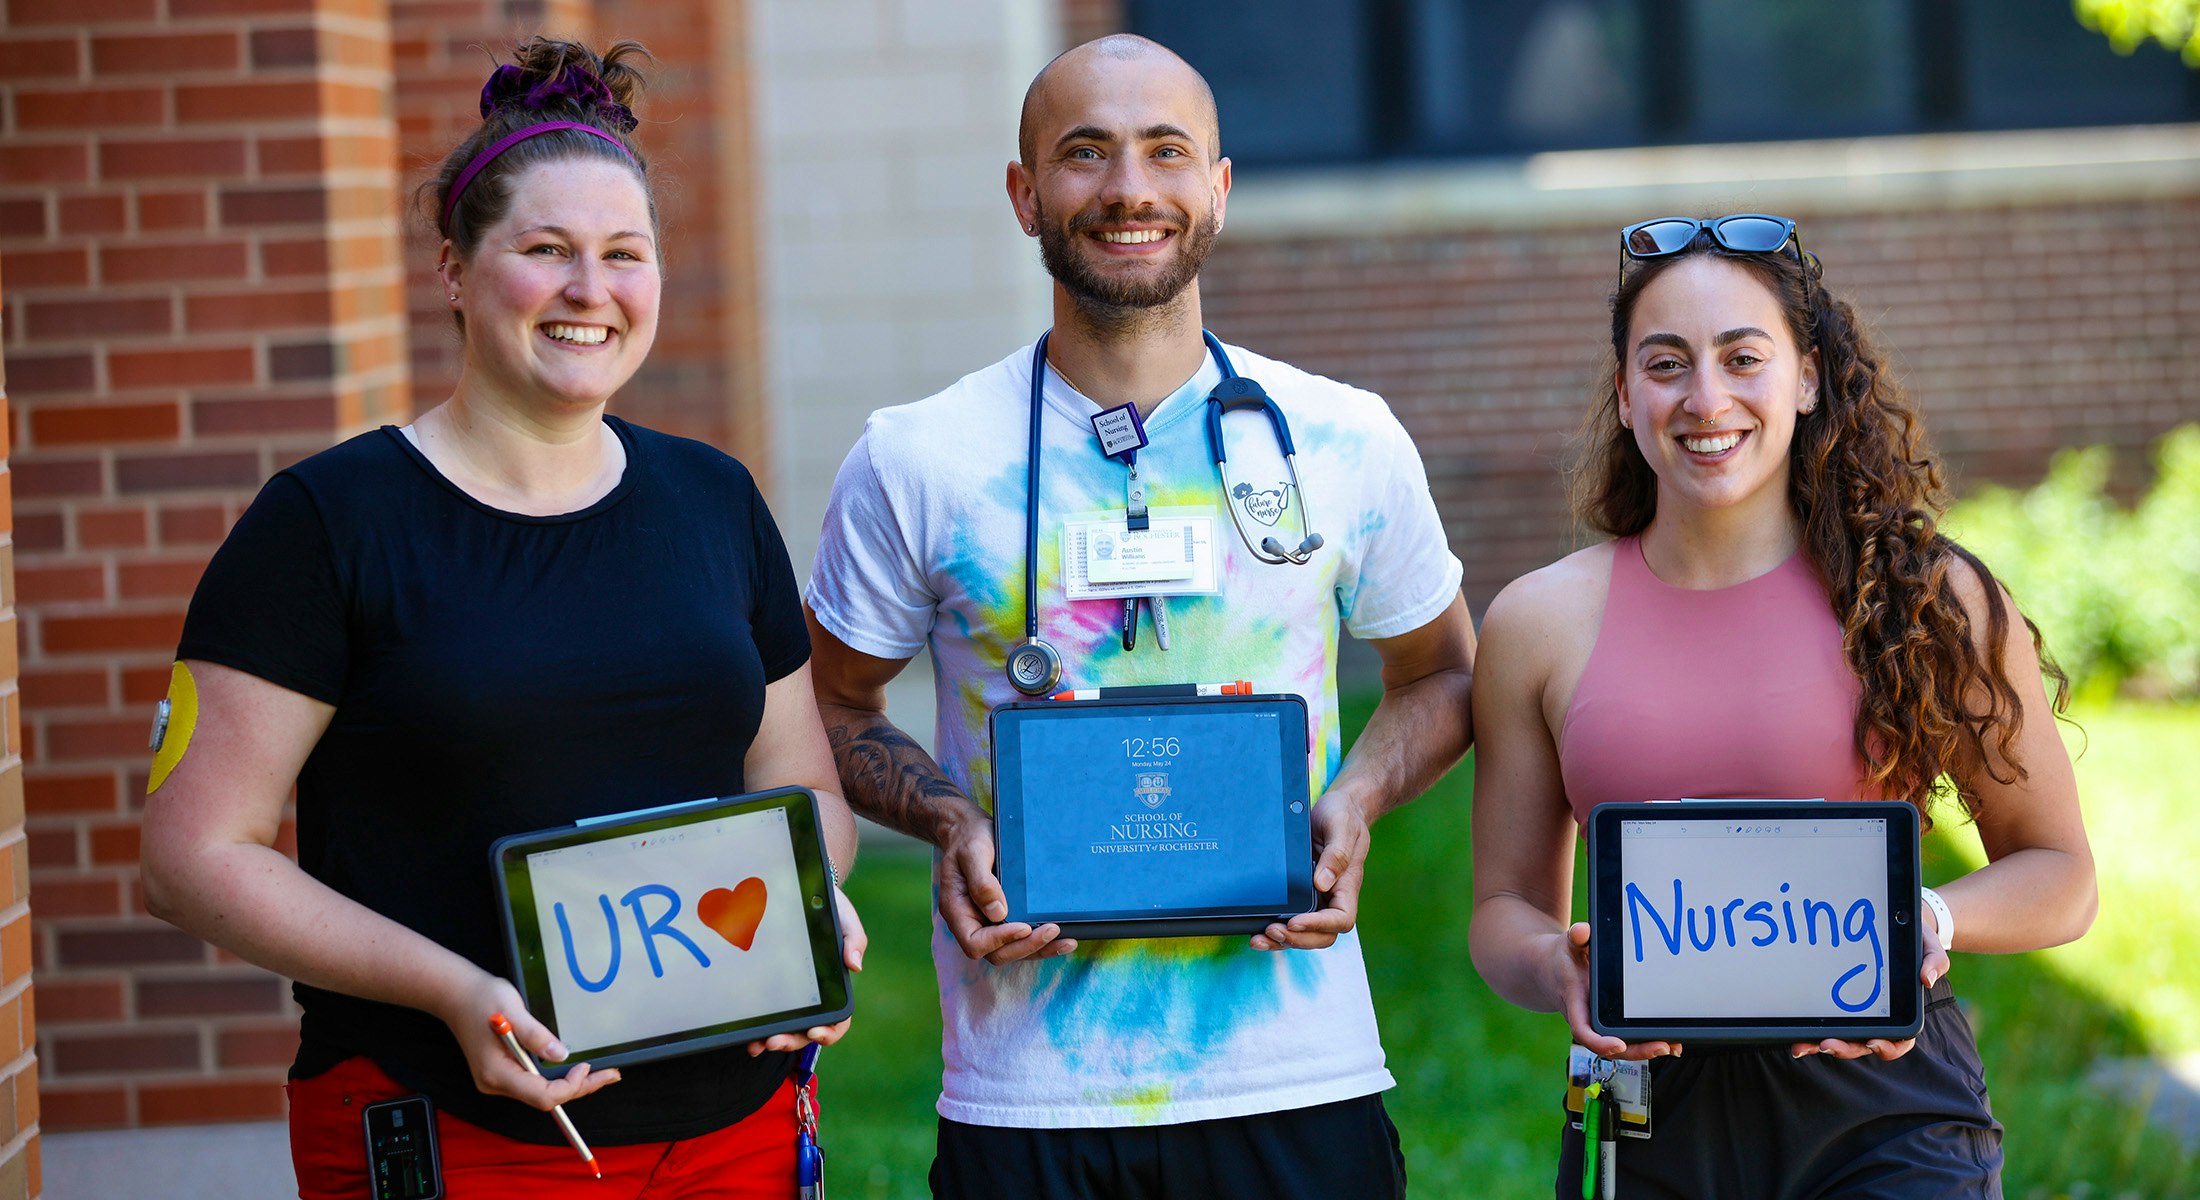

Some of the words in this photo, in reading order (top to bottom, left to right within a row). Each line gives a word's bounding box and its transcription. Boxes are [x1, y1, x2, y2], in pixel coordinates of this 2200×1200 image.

[1099, 415, 1119, 428] School
[1104, 425, 1129, 436] Nursing
[1134, 531, 1180, 540] ROCHESTER
[1121, 736, 1181, 758] 12:56
[1124, 813, 1168, 823] SCHOOL
[1169, 812, 1183, 821] OF
[1110, 821, 1198, 840] NURSING
[1091, 843, 1151, 854] UNIVERSITY
[1159, 841, 1219, 852] ROCHESTER
[553, 883, 711, 993] UR
[1625, 878, 1884, 1013] Nursing
